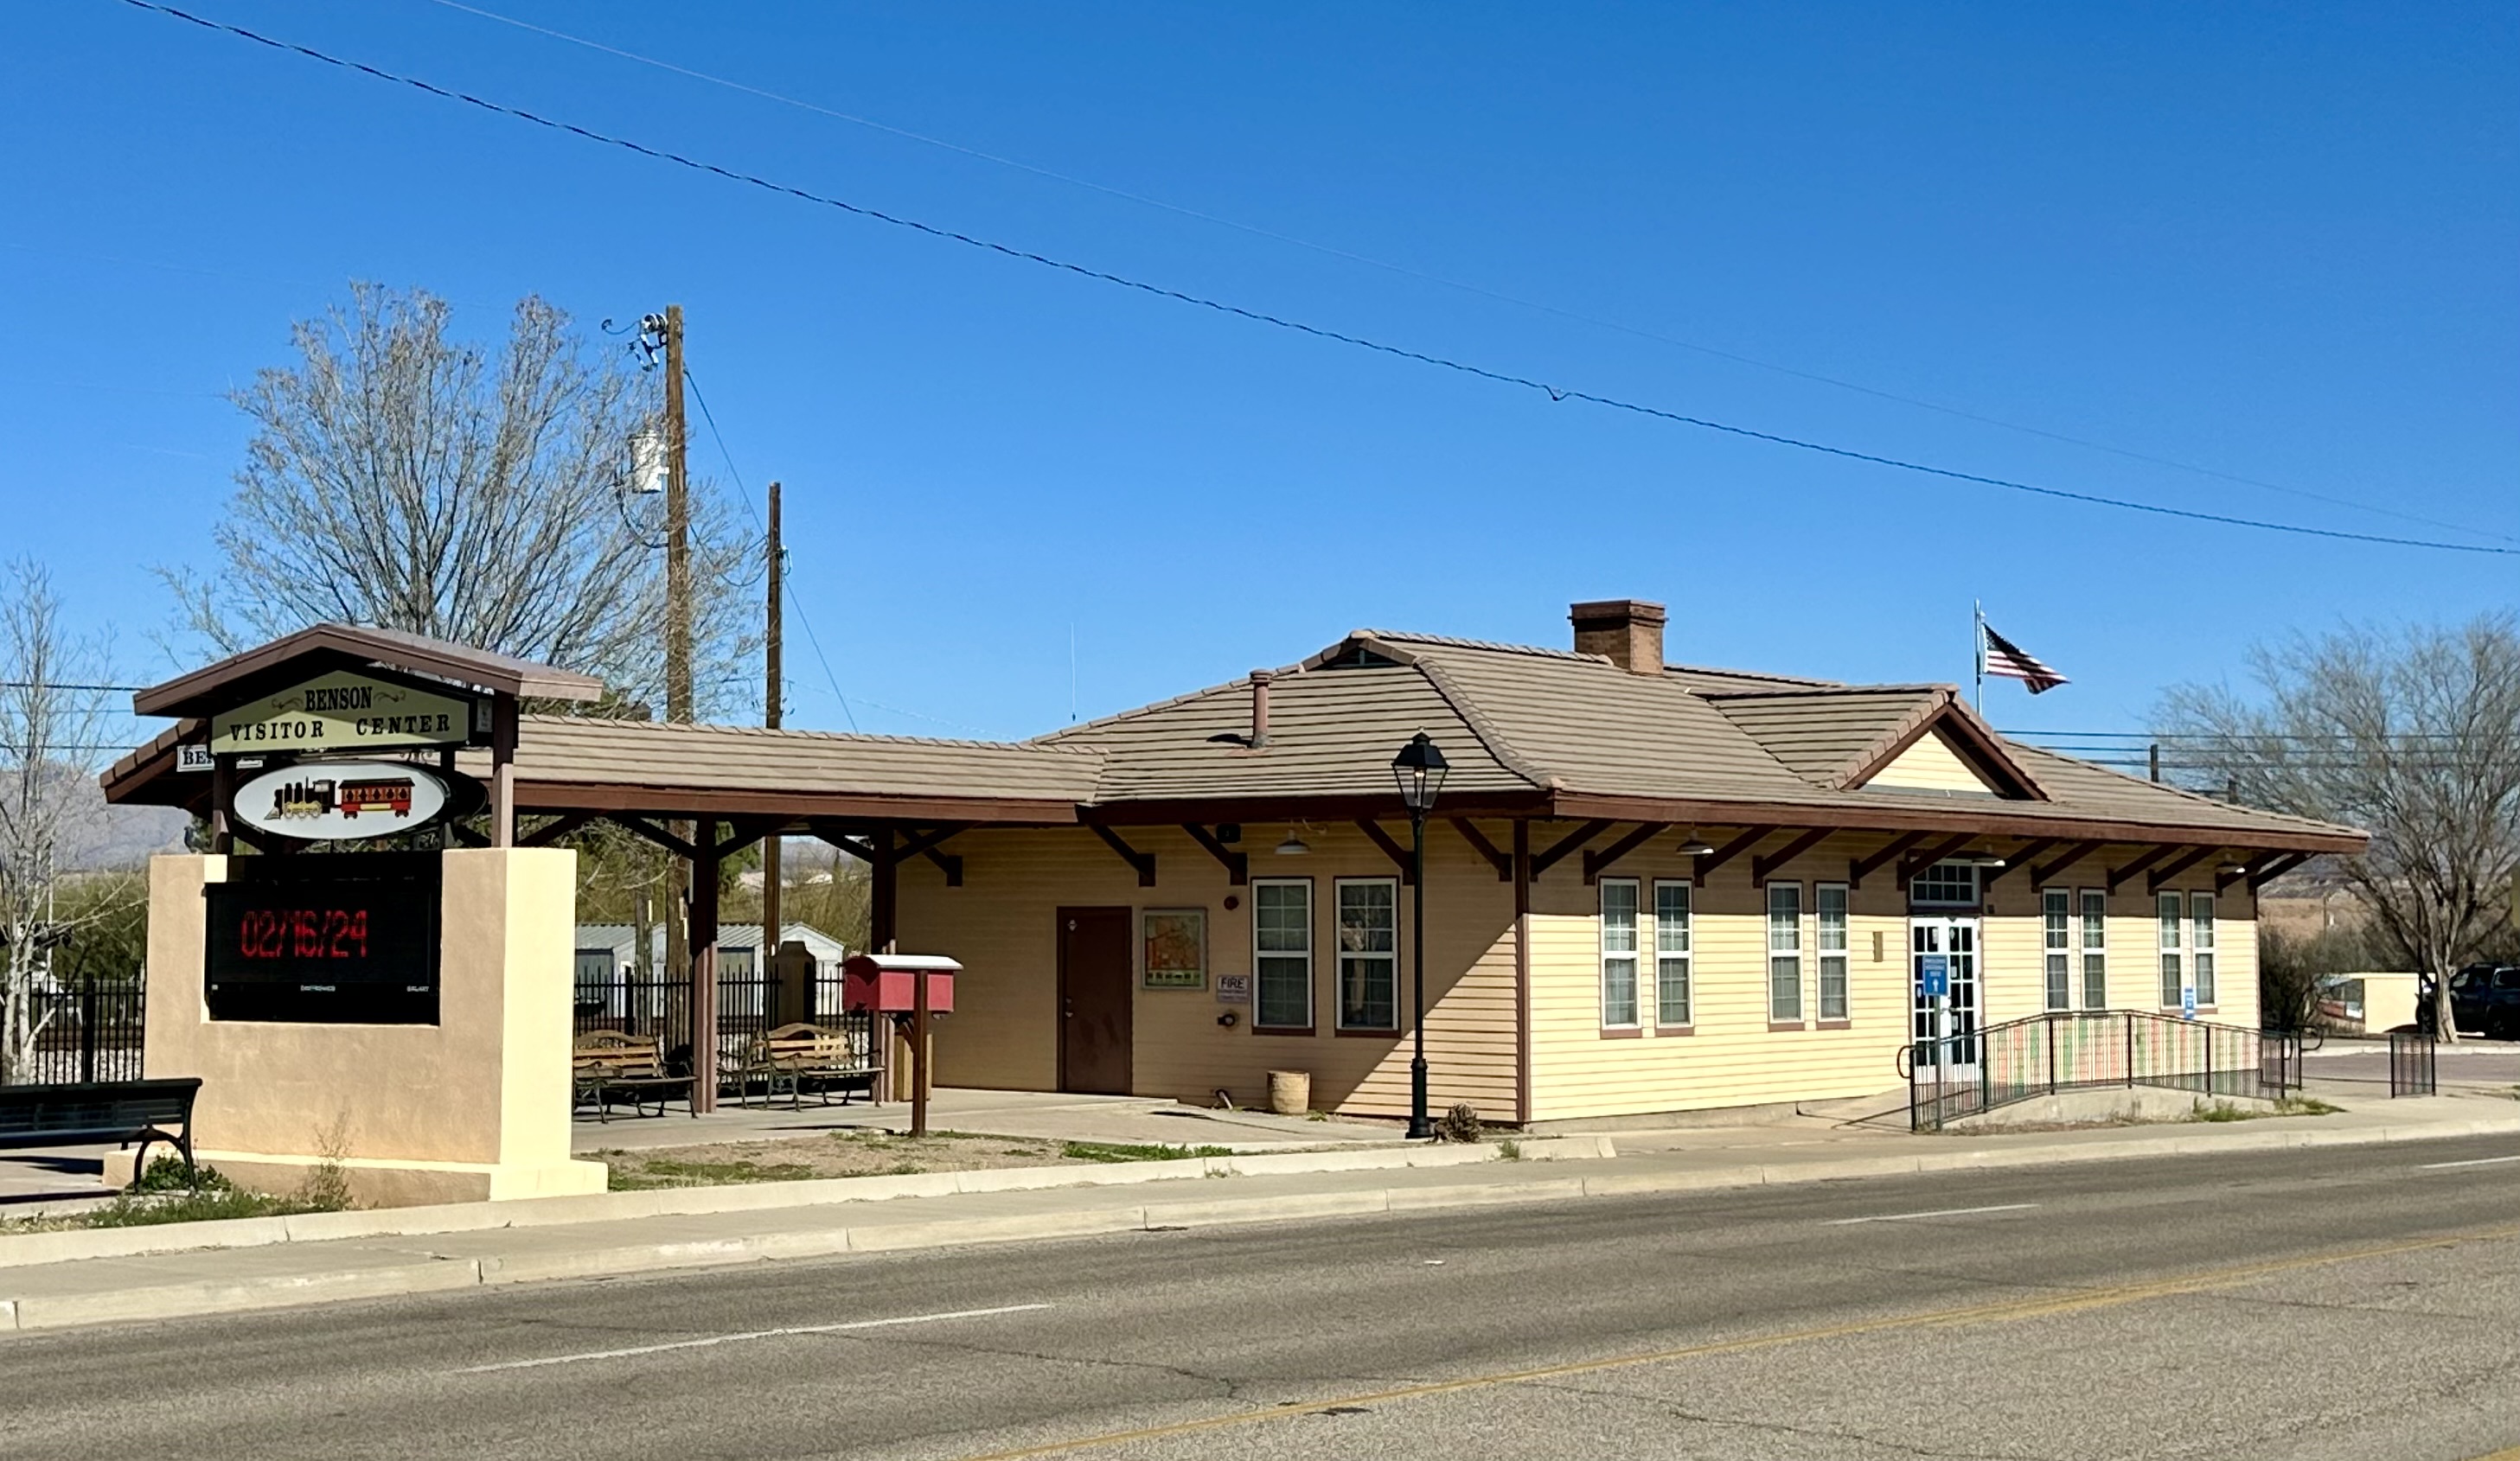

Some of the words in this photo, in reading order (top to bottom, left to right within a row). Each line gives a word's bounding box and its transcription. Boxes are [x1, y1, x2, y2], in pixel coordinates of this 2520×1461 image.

[304, 686, 373, 711] BENSON
[229, 720, 324, 741] VISITOR
[355, 714, 450, 736] CENTER
[240, 909, 368, 958] 02/16/24
[1220, 977, 1245, 989] FIRE
